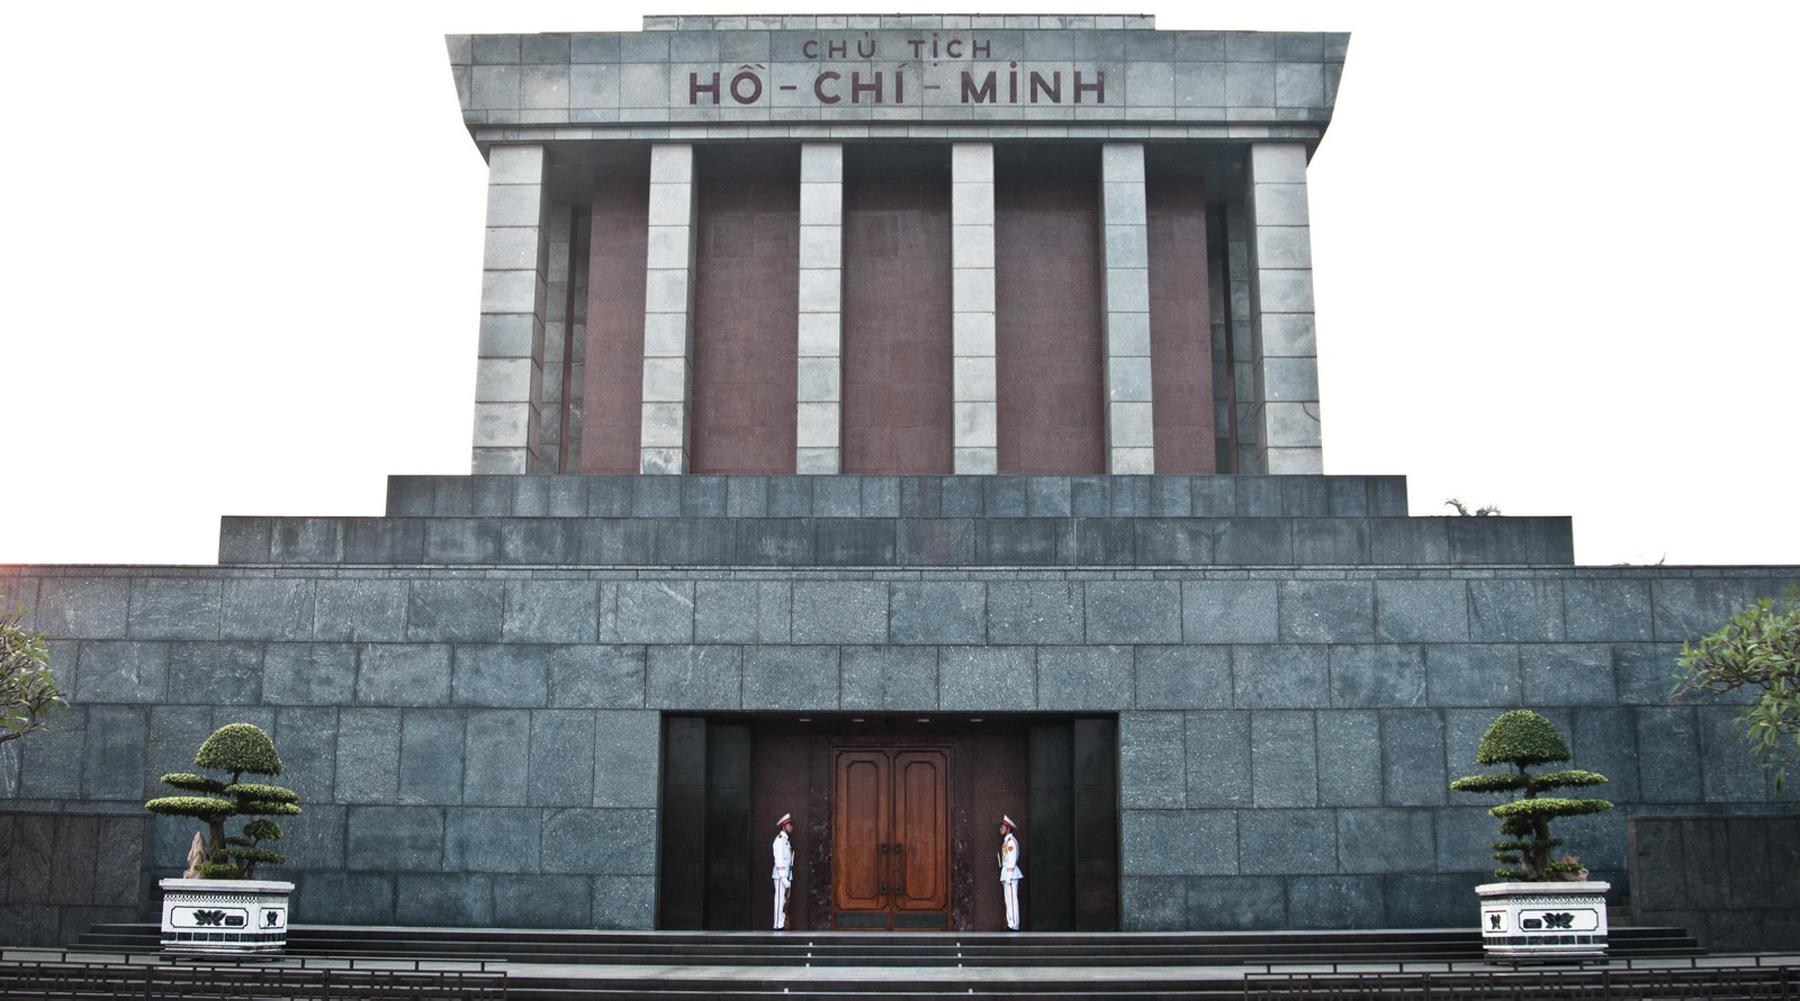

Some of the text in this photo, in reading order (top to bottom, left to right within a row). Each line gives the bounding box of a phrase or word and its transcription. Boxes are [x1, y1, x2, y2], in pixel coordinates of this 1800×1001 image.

[802, 31, 876, 59] CHỦ
[689, 63, 766, 105] HỒ
[813, 62, 908, 105] CHÍ
